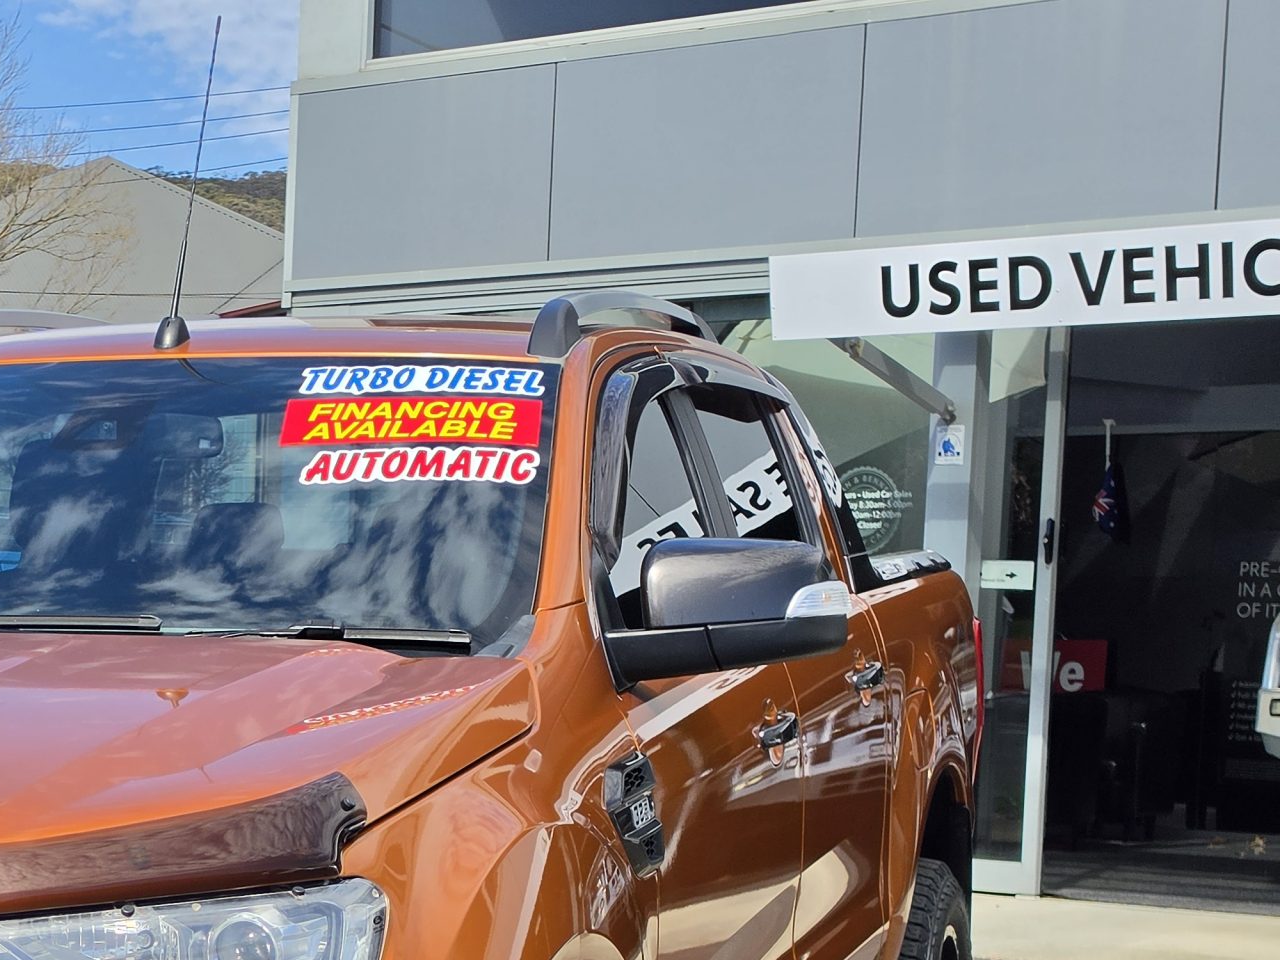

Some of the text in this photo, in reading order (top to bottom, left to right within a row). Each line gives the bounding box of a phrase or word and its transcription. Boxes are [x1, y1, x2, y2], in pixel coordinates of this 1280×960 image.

[881, 255, 1053, 319] USED
[304, 367, 542, 394] TURBO DIESEL
[308, 401, 516, 423] FINANCING
[302, 420, 518, 441] AVAILABLE
[304, 449, 536, 482] AUTOMATIC
[1237, 581, 1256, 598] IN
[1260, 581, 1272, 598] A
[1236, 601, 1262, 619] OF
